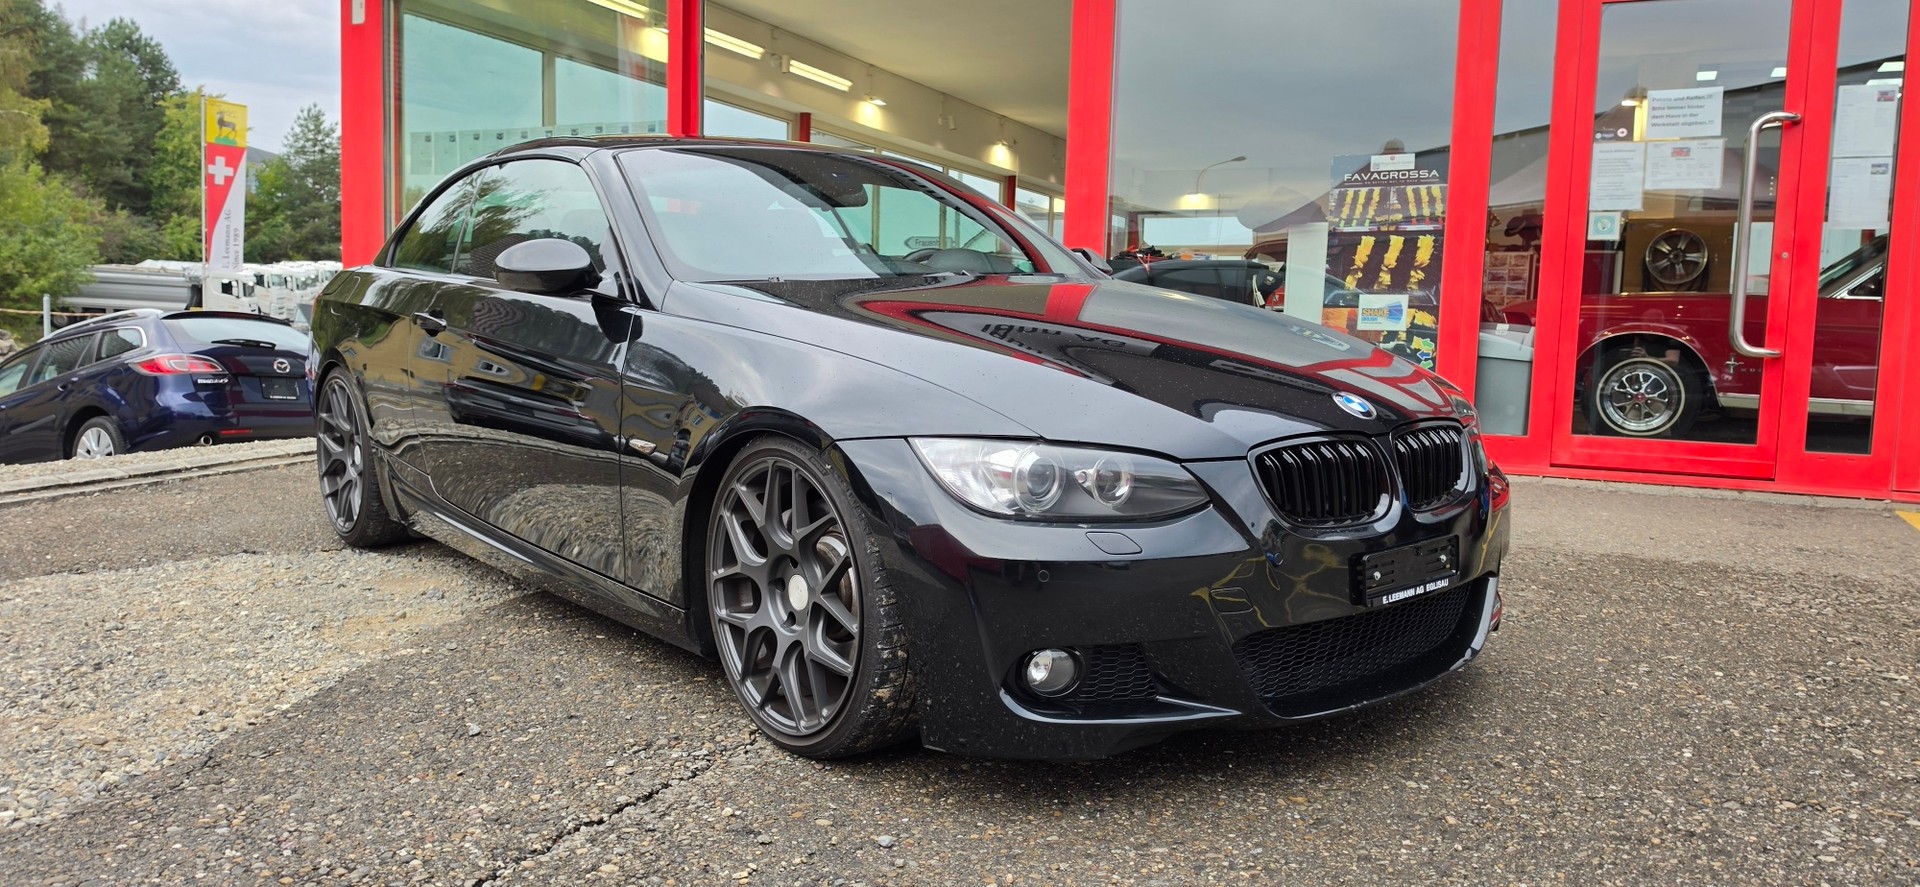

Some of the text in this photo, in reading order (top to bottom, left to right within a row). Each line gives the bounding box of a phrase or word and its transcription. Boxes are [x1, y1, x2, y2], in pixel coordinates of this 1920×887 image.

[1344, 169, 1439, 181] FAVAGROSSA
[224, 209, 232, 222] AG
[222, 224, 231, 260] Leemann
[232, 249, 241, 270] Since
[1388, 588, 1415, 601] LEEMANN
[1416, 586, 1424, 595] AG
[1426, 579, 1449, 591] EGLISAU
